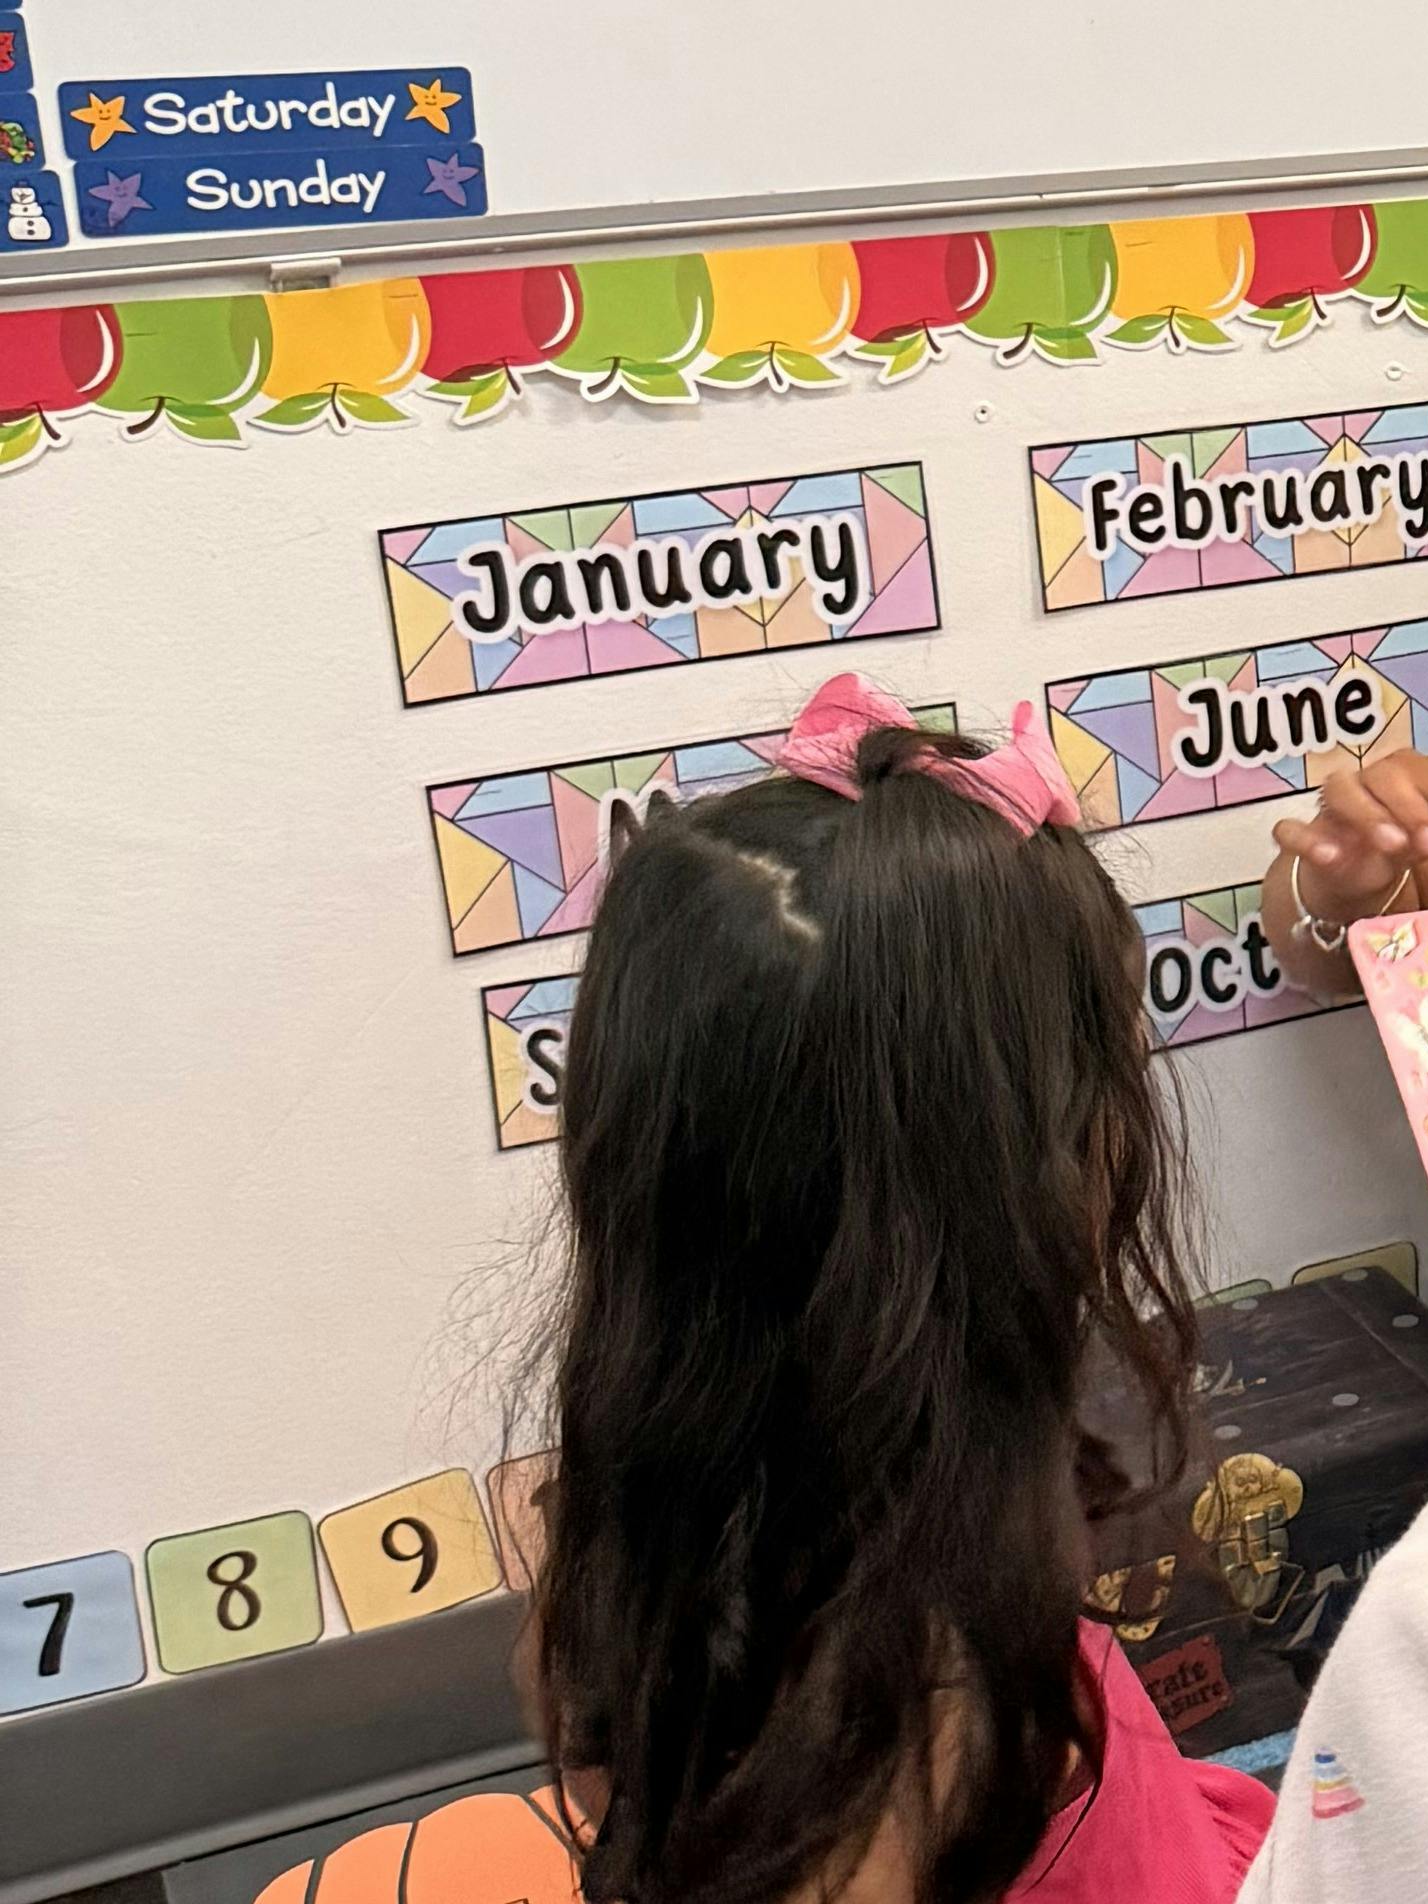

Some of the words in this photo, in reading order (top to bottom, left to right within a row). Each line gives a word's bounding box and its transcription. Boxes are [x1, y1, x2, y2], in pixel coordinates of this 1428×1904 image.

[143, 81, 396, 137] Saturday
[187, 159, 385, 212] Sunday
[462, 520, 860, 634] January
[1180, 678, 1375, 767] June
[206, 1550, 262, 1632] 8
[381, 1517, 438, 1594] 9
[23, 1592, 75, 1677] 7
